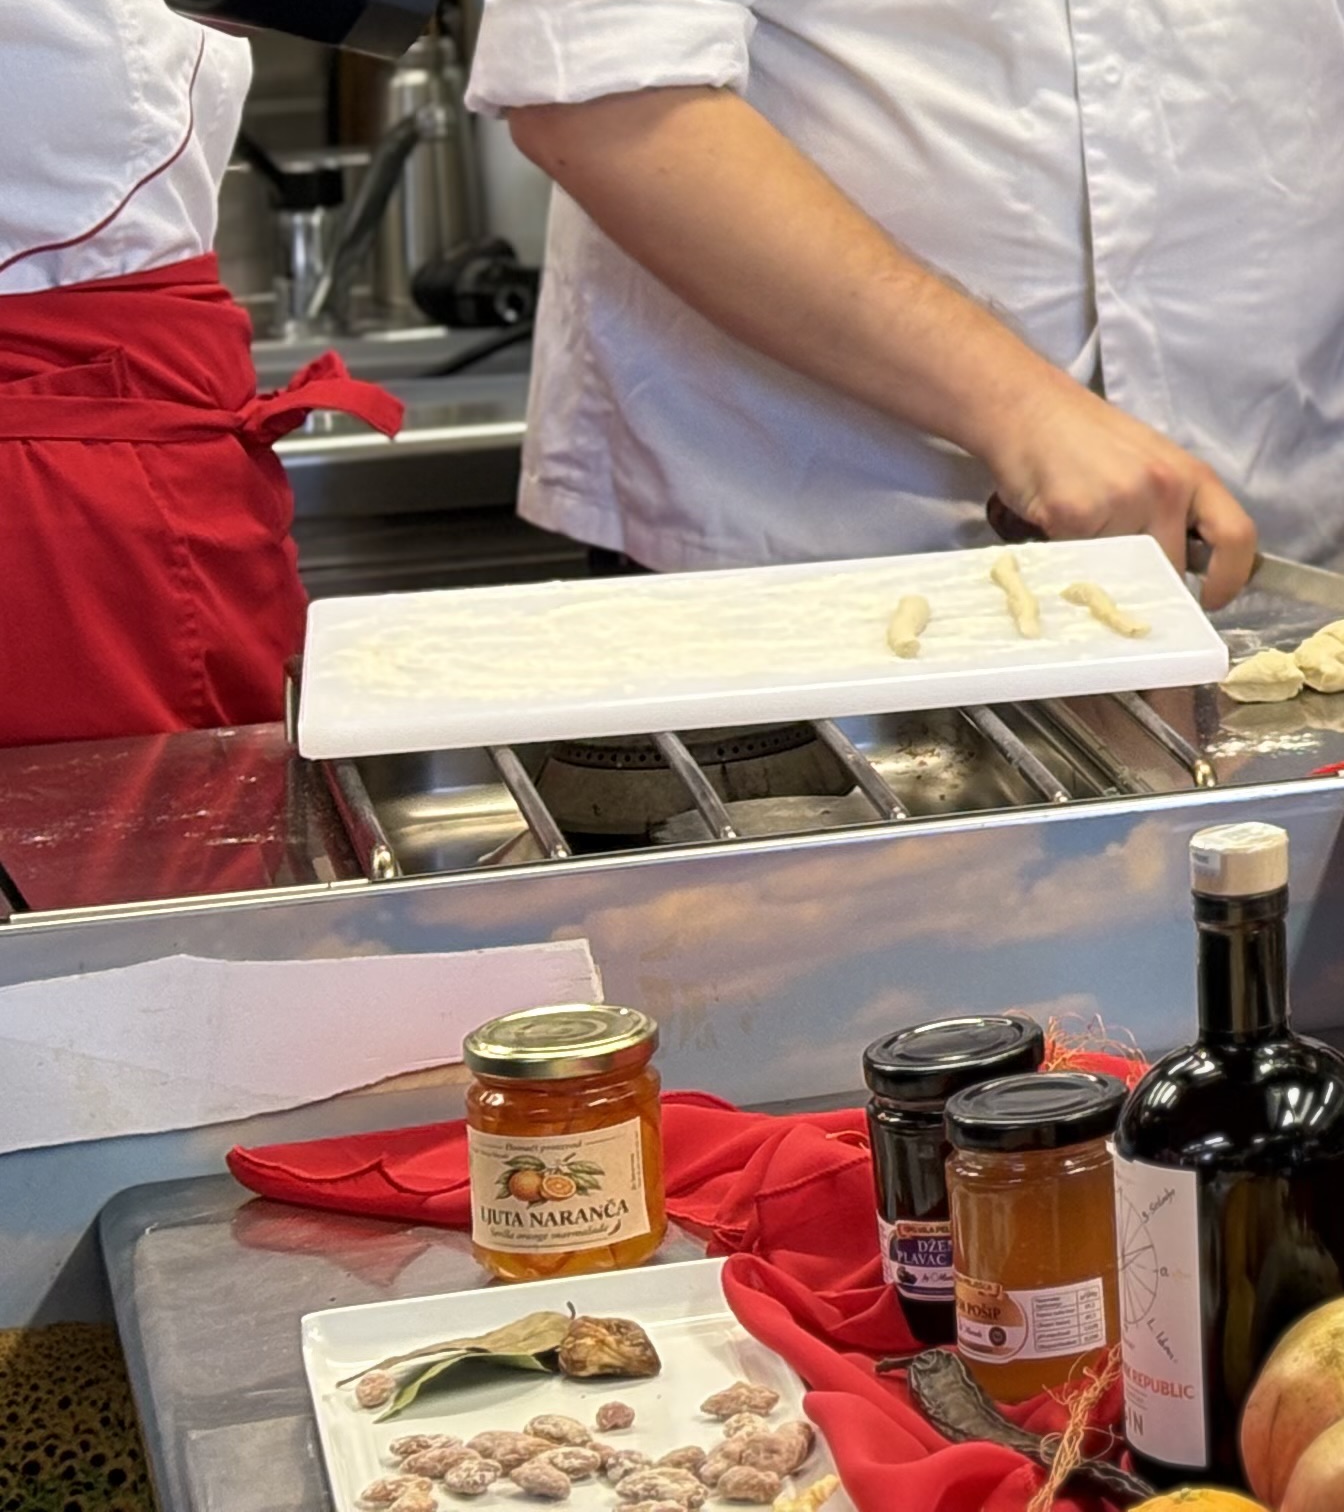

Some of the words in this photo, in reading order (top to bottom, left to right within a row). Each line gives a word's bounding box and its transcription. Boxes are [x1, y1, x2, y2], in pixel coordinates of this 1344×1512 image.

[529, 1198, 630, 1228] NARANČA
[896, 1250, 946, 1266] PLAVAC
[1132, 1368, 1196, 1401] REPUBLIC
[1125, 1406, 1144, 1437] IN
